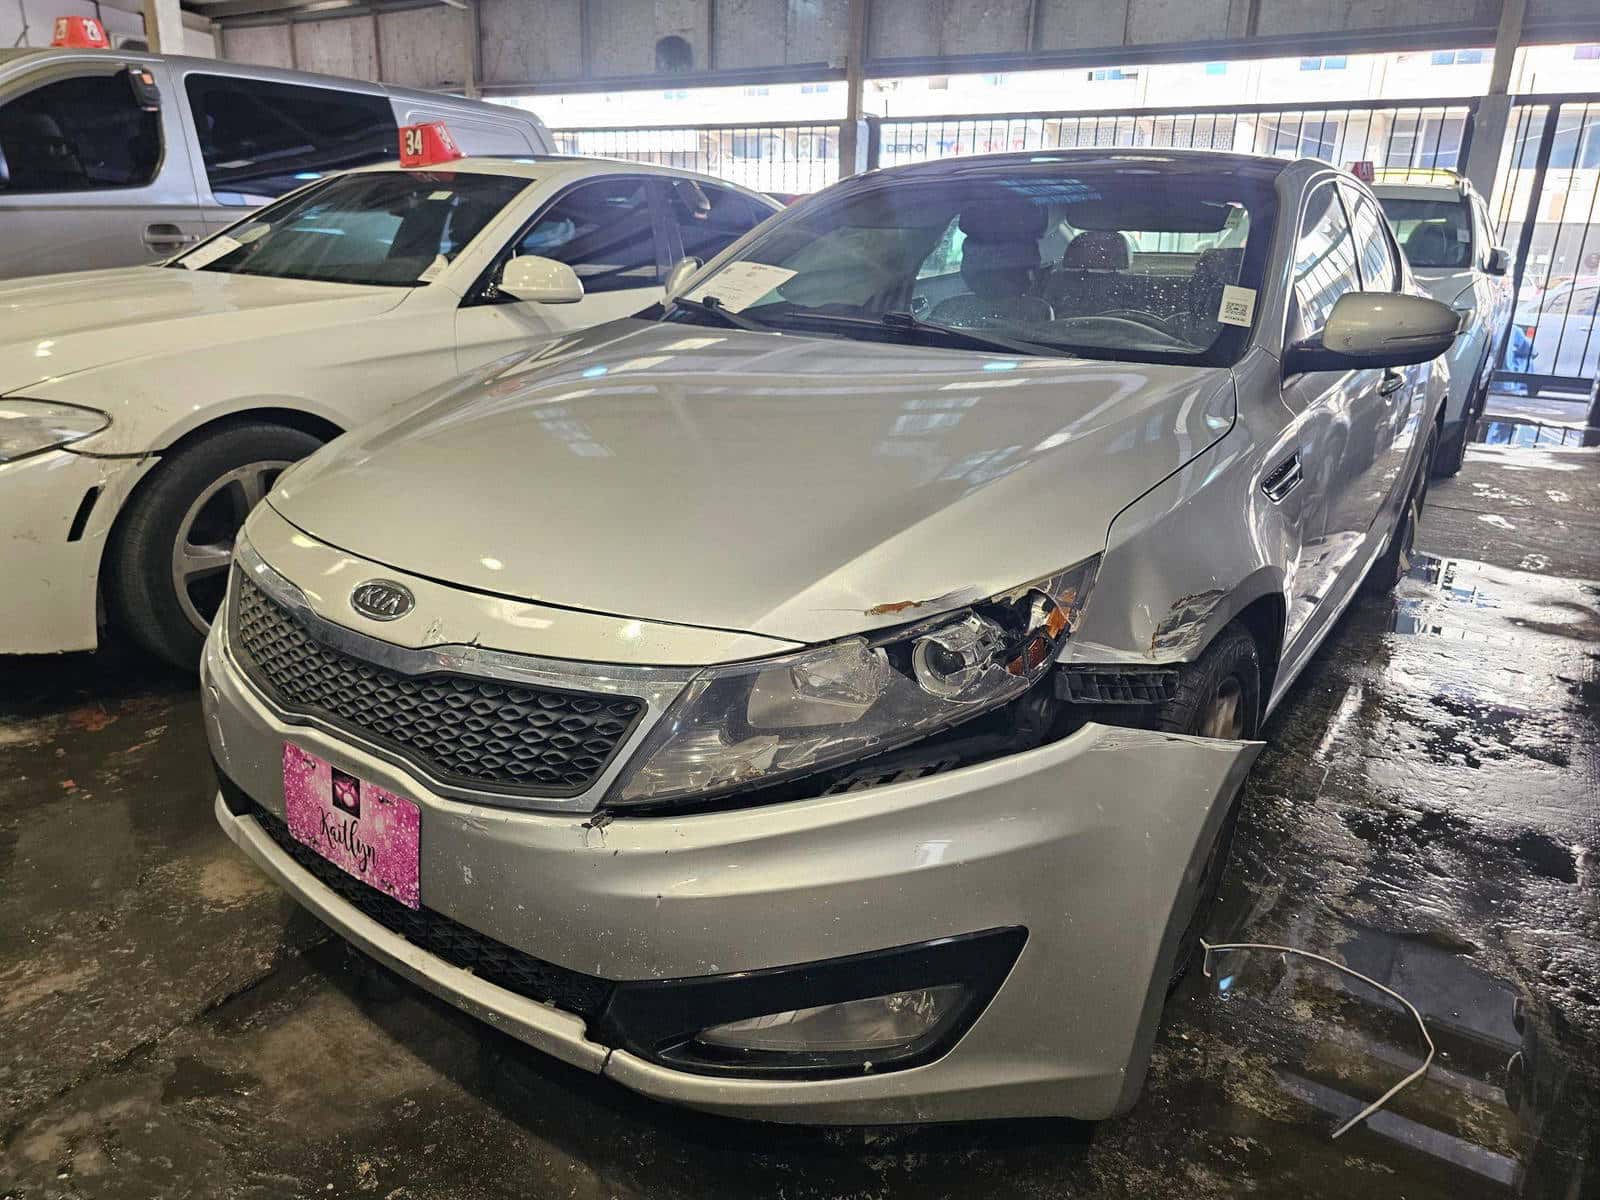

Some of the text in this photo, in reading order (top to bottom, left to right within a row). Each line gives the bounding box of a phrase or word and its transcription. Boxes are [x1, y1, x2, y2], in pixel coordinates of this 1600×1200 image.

[406, 128, 422, 156] 34
[358, 586, 401, 614] KIA
[319, 806, 378, 873] Kaitlyn
